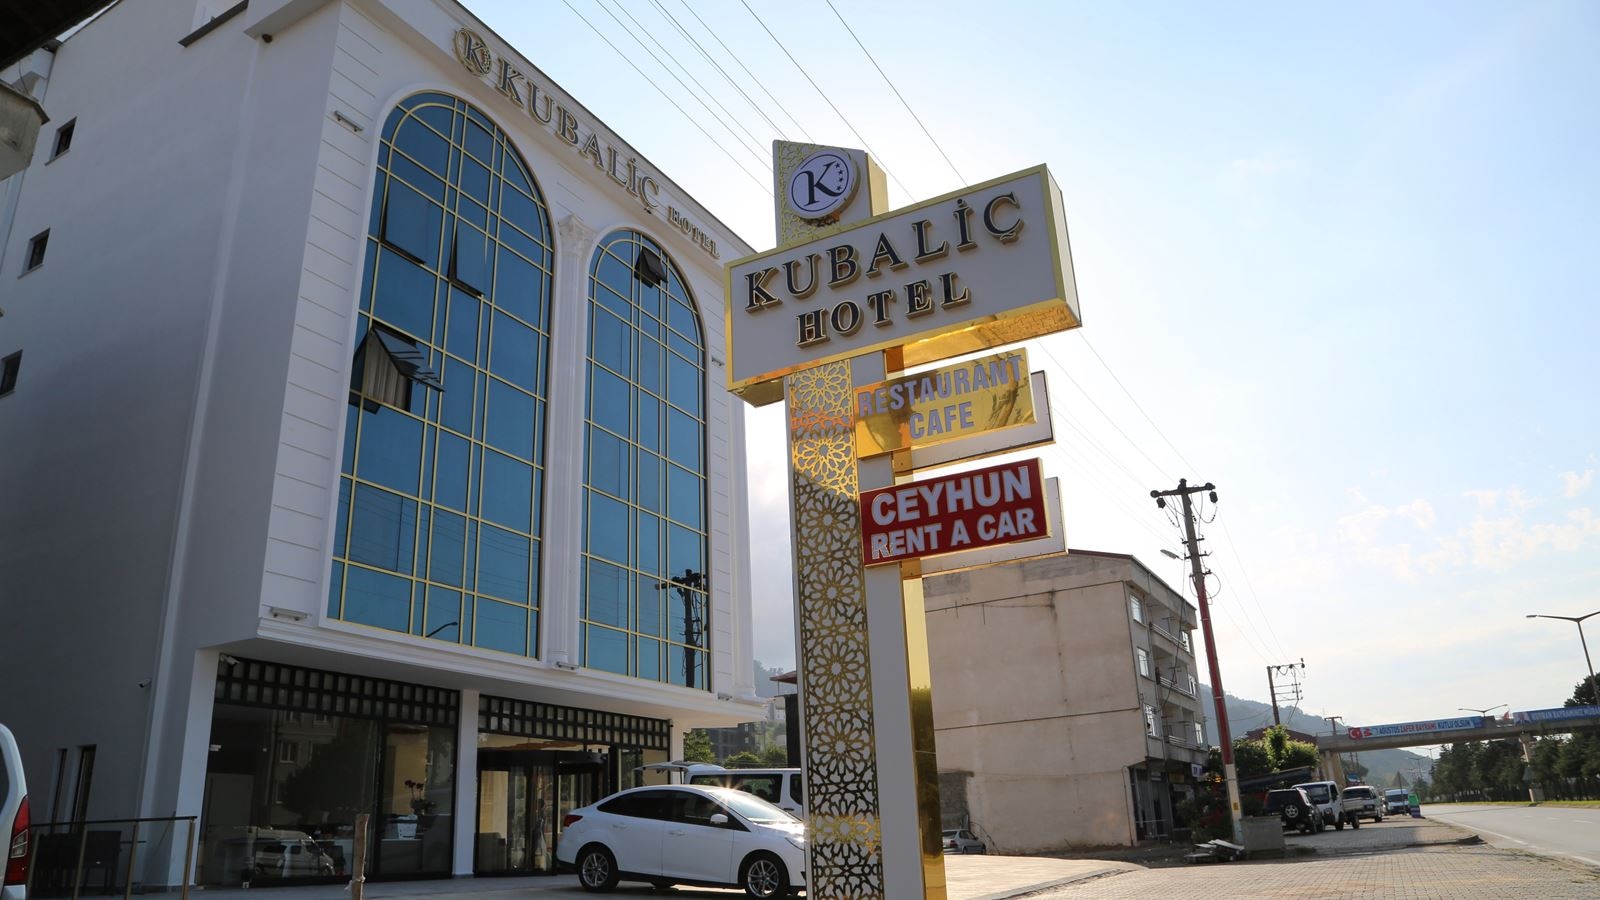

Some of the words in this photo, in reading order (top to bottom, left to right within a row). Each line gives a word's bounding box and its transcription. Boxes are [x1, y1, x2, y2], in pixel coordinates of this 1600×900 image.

[495, 57, 660, 214] KUBALİÇ
[668, 206, 720, 259] HOTEL
[801, 162, 842, 206] K
[744, 191, 1025, 312] KUBALİÇ
[795, 271, 970, 347] HOTEL
[858, 355, 1022, 418] RESTAURANT
[909, 401, 975, 439] CAFE
[871, 466, 1032, 526] CEYHUN
[870, 523, 942, 560] RENT
[950, 519, 971, 546] A
[976, 507, 1037, 541] CAR
